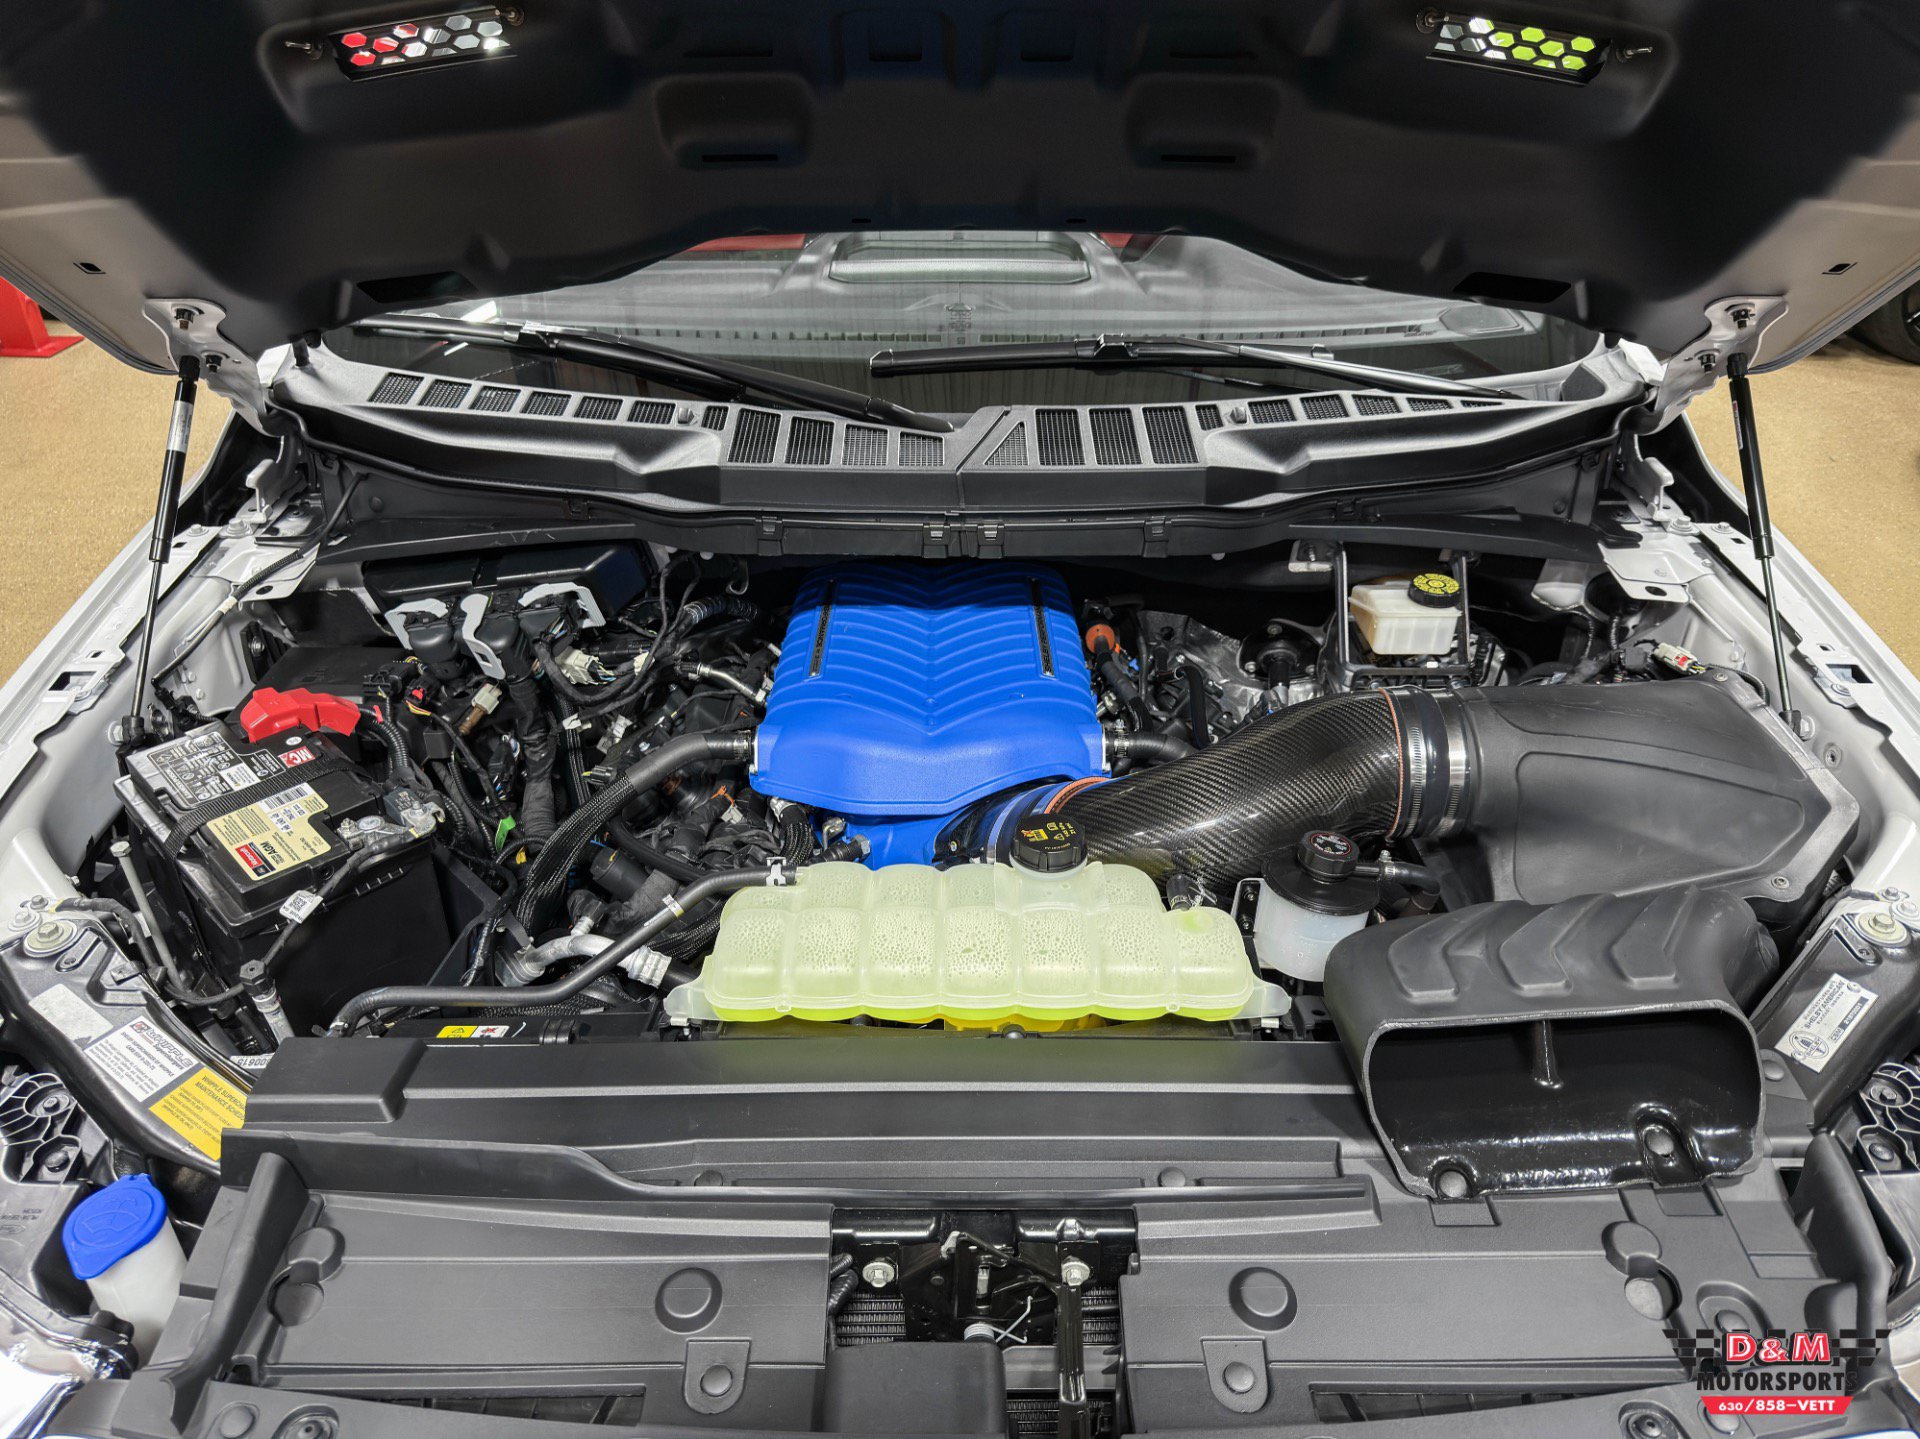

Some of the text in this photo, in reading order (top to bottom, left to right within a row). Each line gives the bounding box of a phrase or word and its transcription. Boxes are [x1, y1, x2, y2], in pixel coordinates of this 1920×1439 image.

[1041, 645, 1051, 671] SHELBY
[259, 840, 278, 855] AGM
[1804, 979, 1845, 1029] SHELBY AMERICAN
[152, 1043, 184, 1071] Superchargers
[1805, 1036, 1821, 1057] SHELBY
[194, 1081, 227, 1107] MAINTENANCE
[201, 1075, 223, 1092] WHIPPLE
